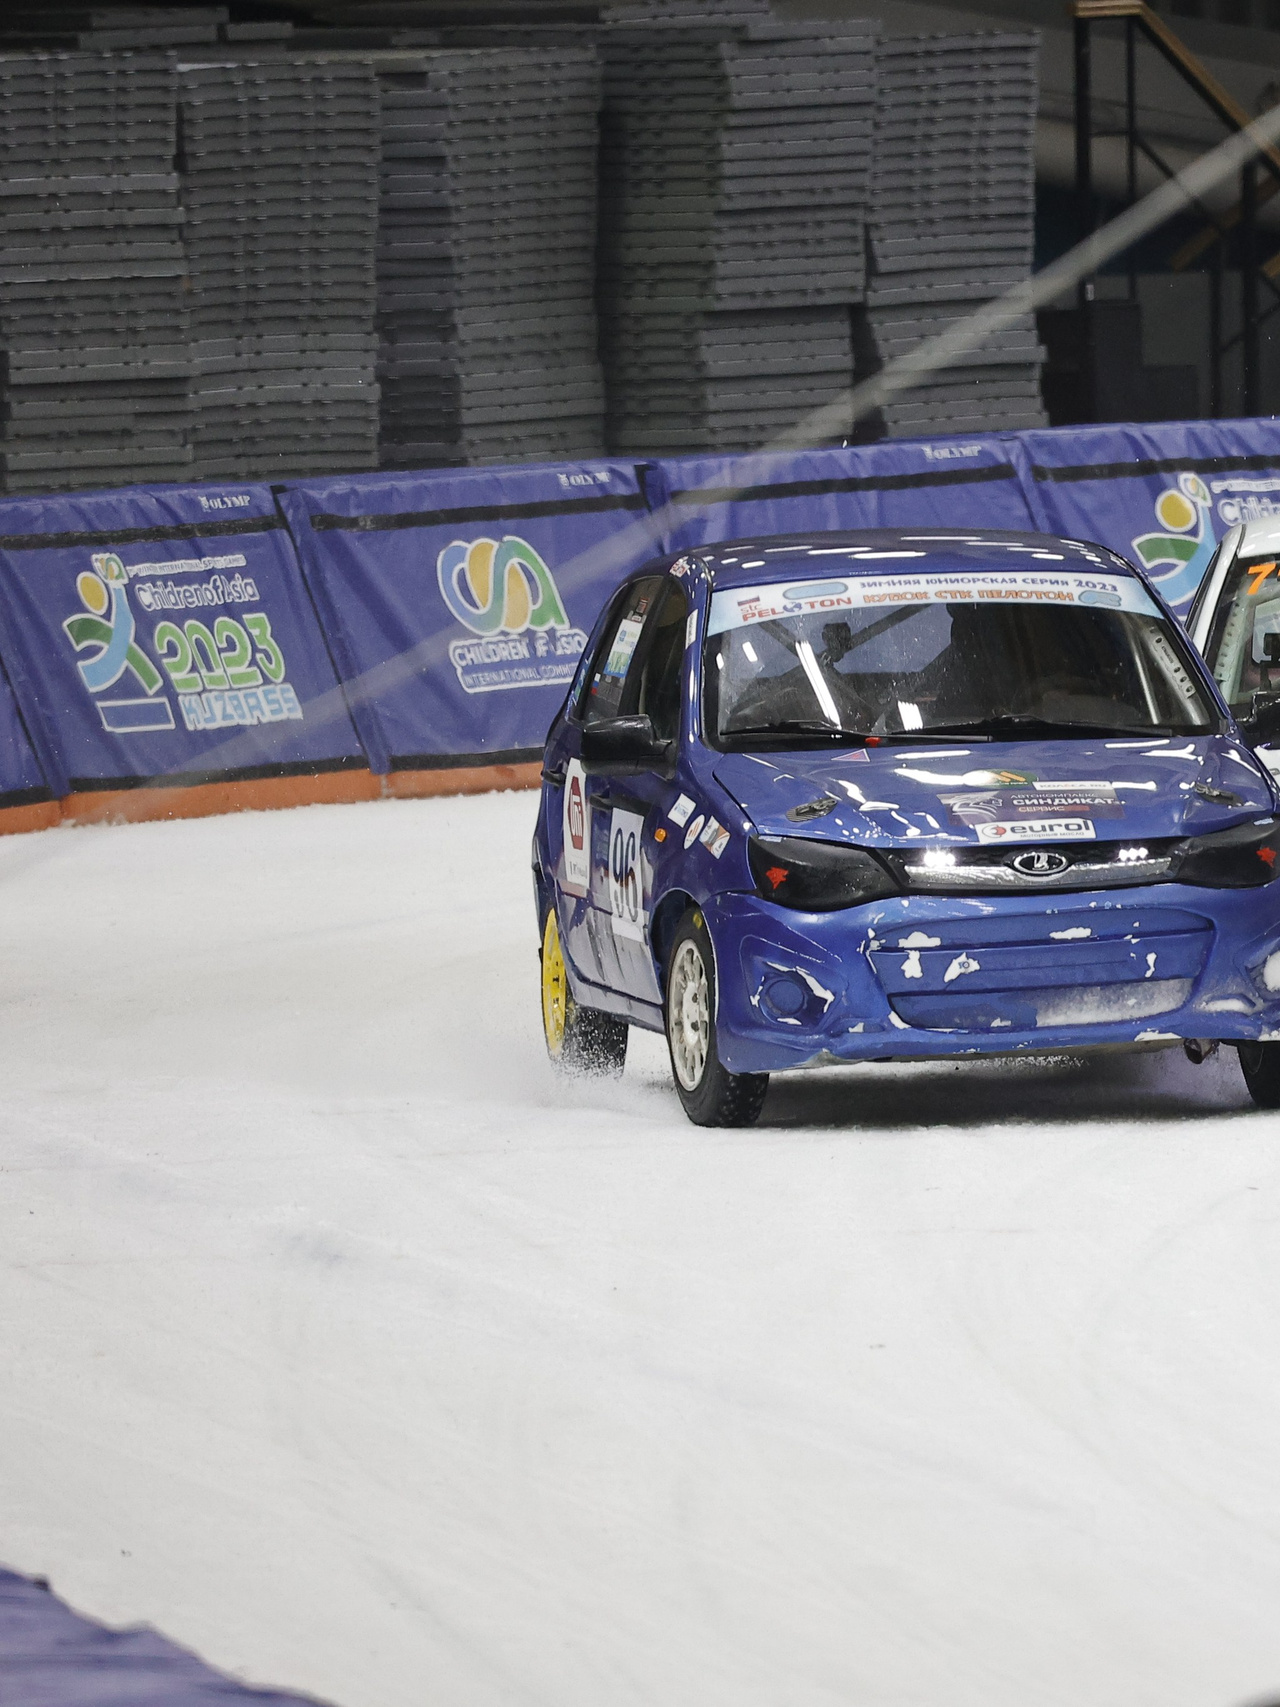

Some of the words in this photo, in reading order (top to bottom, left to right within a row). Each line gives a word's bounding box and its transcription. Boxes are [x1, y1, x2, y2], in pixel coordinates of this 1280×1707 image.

[859, 577, 921, 589] ЗИМНЯЯ
[925, 577, 1018, 586] ЮНИОРСКАЯ
[1022, 577, 1070, 587] СЕРИЯ
[1073, 578, 1119, 592] 2023
[863, 591, 931, 604] КУБОК
[935, 590, 974, 600] СТК
[155, 613, 285, 692] 2023
[1013, 798, 1115, 806] СИНДИКАТ
[1010, 820, 1090, 834] eurol
[613, 827, 638, 922] 96
